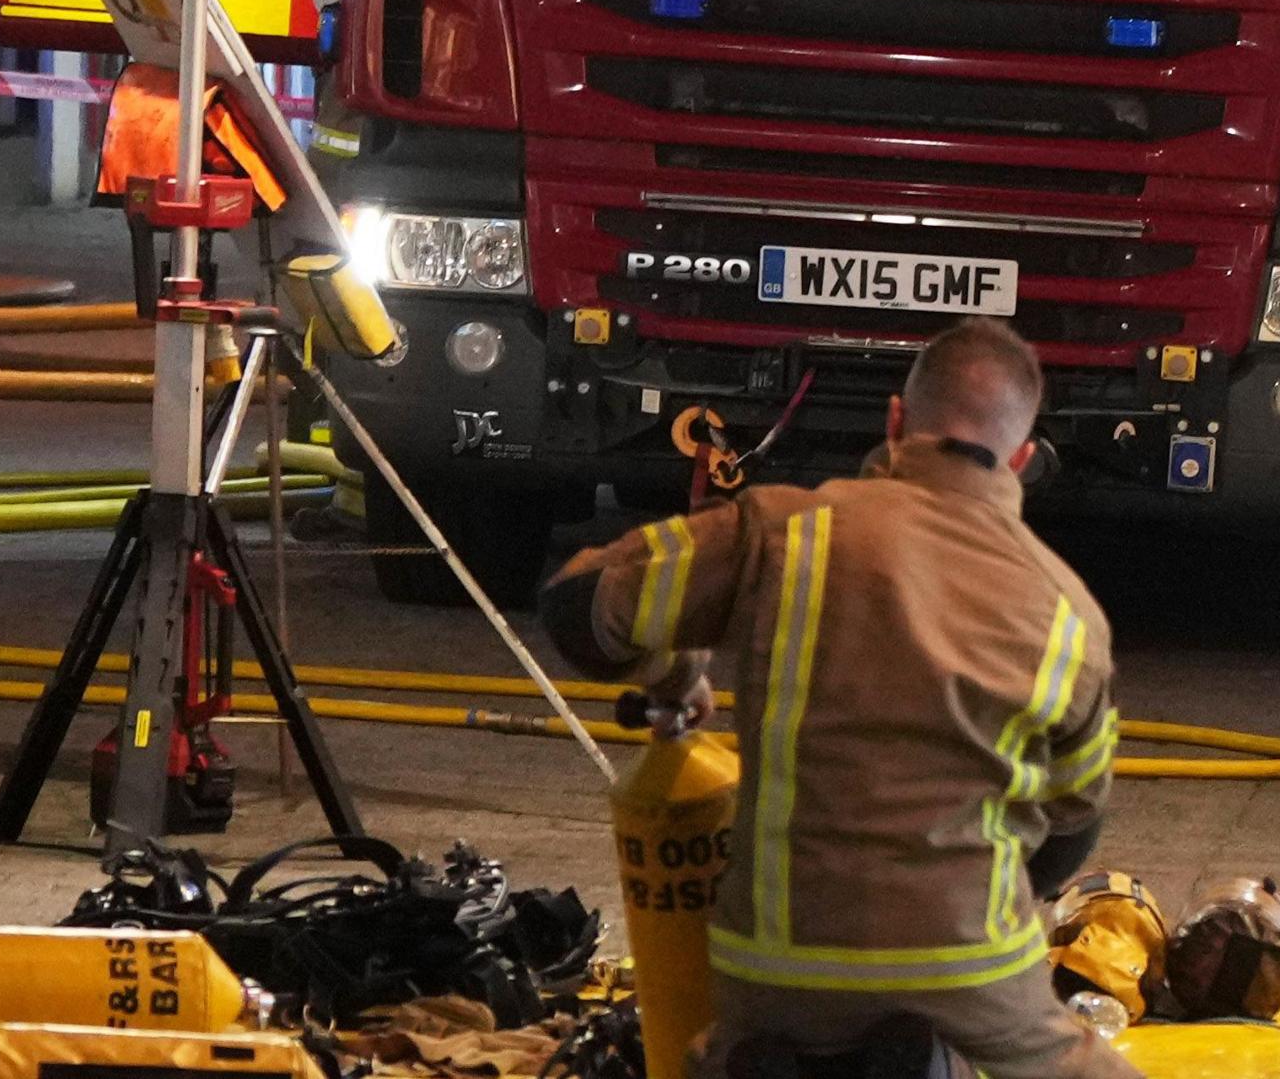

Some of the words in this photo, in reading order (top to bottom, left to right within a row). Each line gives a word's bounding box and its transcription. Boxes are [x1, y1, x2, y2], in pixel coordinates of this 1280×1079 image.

[627, 252, 655, 279] P
[663, 254, 752, 283] 280
[800, 255, 899, 301] WX15
[912, 262, 1001, 306] GMF
[763, 283, 782, 295] GB
[146, 940, 180, 1016] BAR
